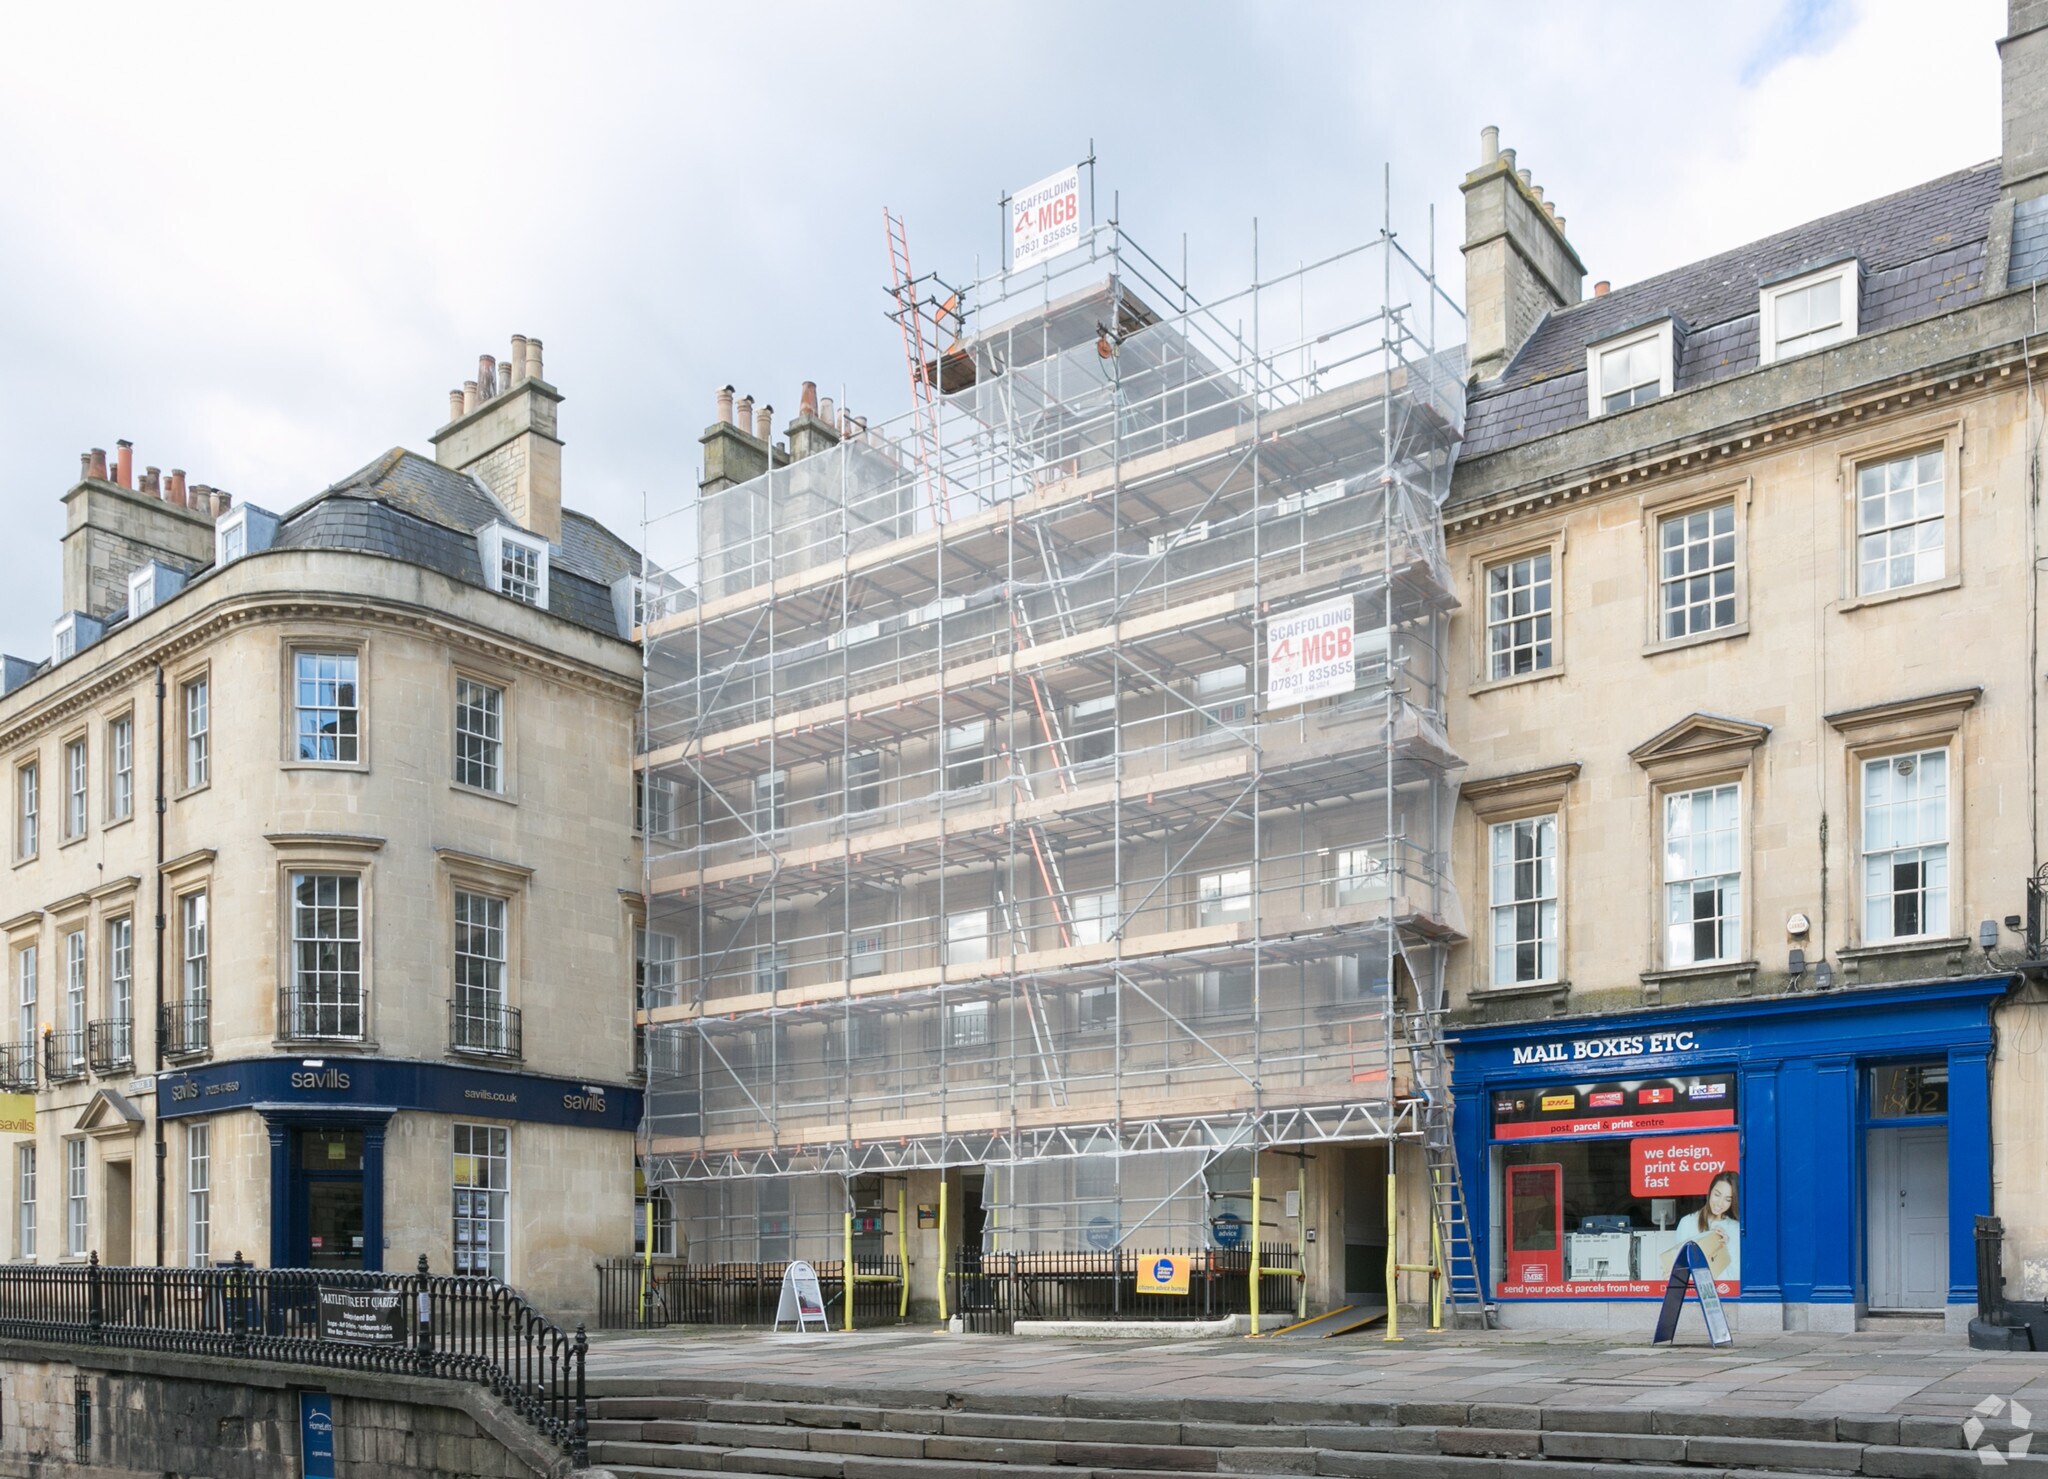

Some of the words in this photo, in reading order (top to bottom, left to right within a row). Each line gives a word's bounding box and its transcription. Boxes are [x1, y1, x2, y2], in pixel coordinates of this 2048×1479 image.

[1015, 176, 1077, 215] SCAFFOLDING
[1038, 193, 1077, 233] MGB
[1015, 239, 1039, 259] 07831
[1043, 222, 1078, 246] 835855
[1270, 608, 1352, 642] SCAFFOLDING
[1302, 626, 1352, 668] MGB
[1271, 673, 1303, 692] 07831
[1308, 660, 1353, 682] 835855
[1512, 1043, 1568, 1064] MAIL
[1573, 1036, 1644, 1060] BOXES
[1649, 1031, 1700, 1053] ETC.
[291, 1068, 350, 1089] savills
[171, 1080, 199, 1101] savills
[464, 1089, 518, 1103] savills.co.uk
[563, 1093, 606, 1113] savills
[1573, 1121, 1600, 1132] parcel
[1602, 1120, 1609, 1129] &
[1611, 1119, 1633, 1130] print
[1635, 1119, 1664, 1128] centre
[1644, 1149, 1664, 1159] we
[1667, 1145, 1713, 1159] design,
[1644, 1161, 1676, 1175] print
[1679, 1160, 1690, 1172] &
[1693, 1160, 1726, 1173] copy
[1644, 1176, 1670, 1188] fast
[1218, 1229, 1237, 1237] advice
[1504, 1284, 1524, 1293] send
[1525, 1285, 1543, 1294] your
[1546, 1284, 1564, 1294] post
[1565, 1284, 1573, 1293] &
[1575, 1283, 1605, 1293] parcels
[1607, 1283, 1628, 1293] from
[1629, 1282, 1650, 1292] here
